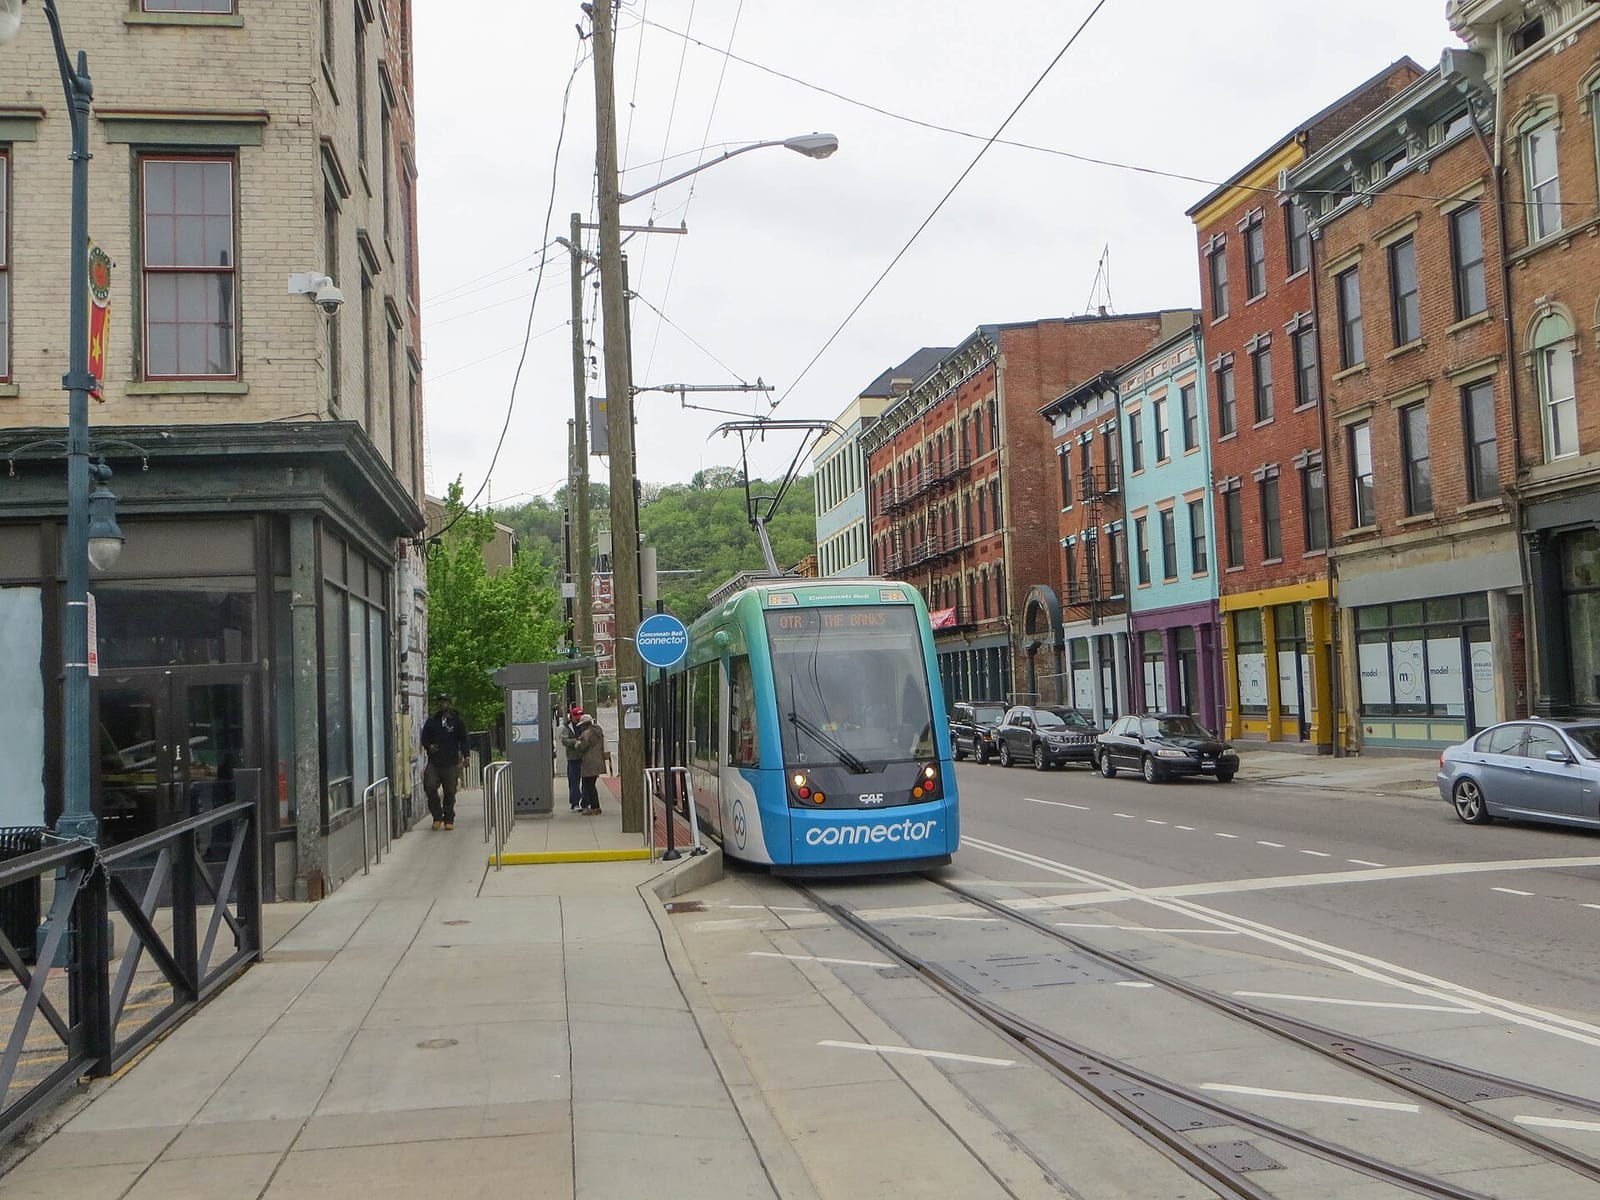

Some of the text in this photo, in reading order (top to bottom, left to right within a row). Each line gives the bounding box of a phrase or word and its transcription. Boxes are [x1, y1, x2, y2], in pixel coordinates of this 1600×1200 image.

[824, 614, 844, 627] THE
[850, 613, 886, 626] BANKS
[639, 636, 686, 645] connector
[859, 792, 884, 804] CAF
[805, 818, 937, 846] connector
